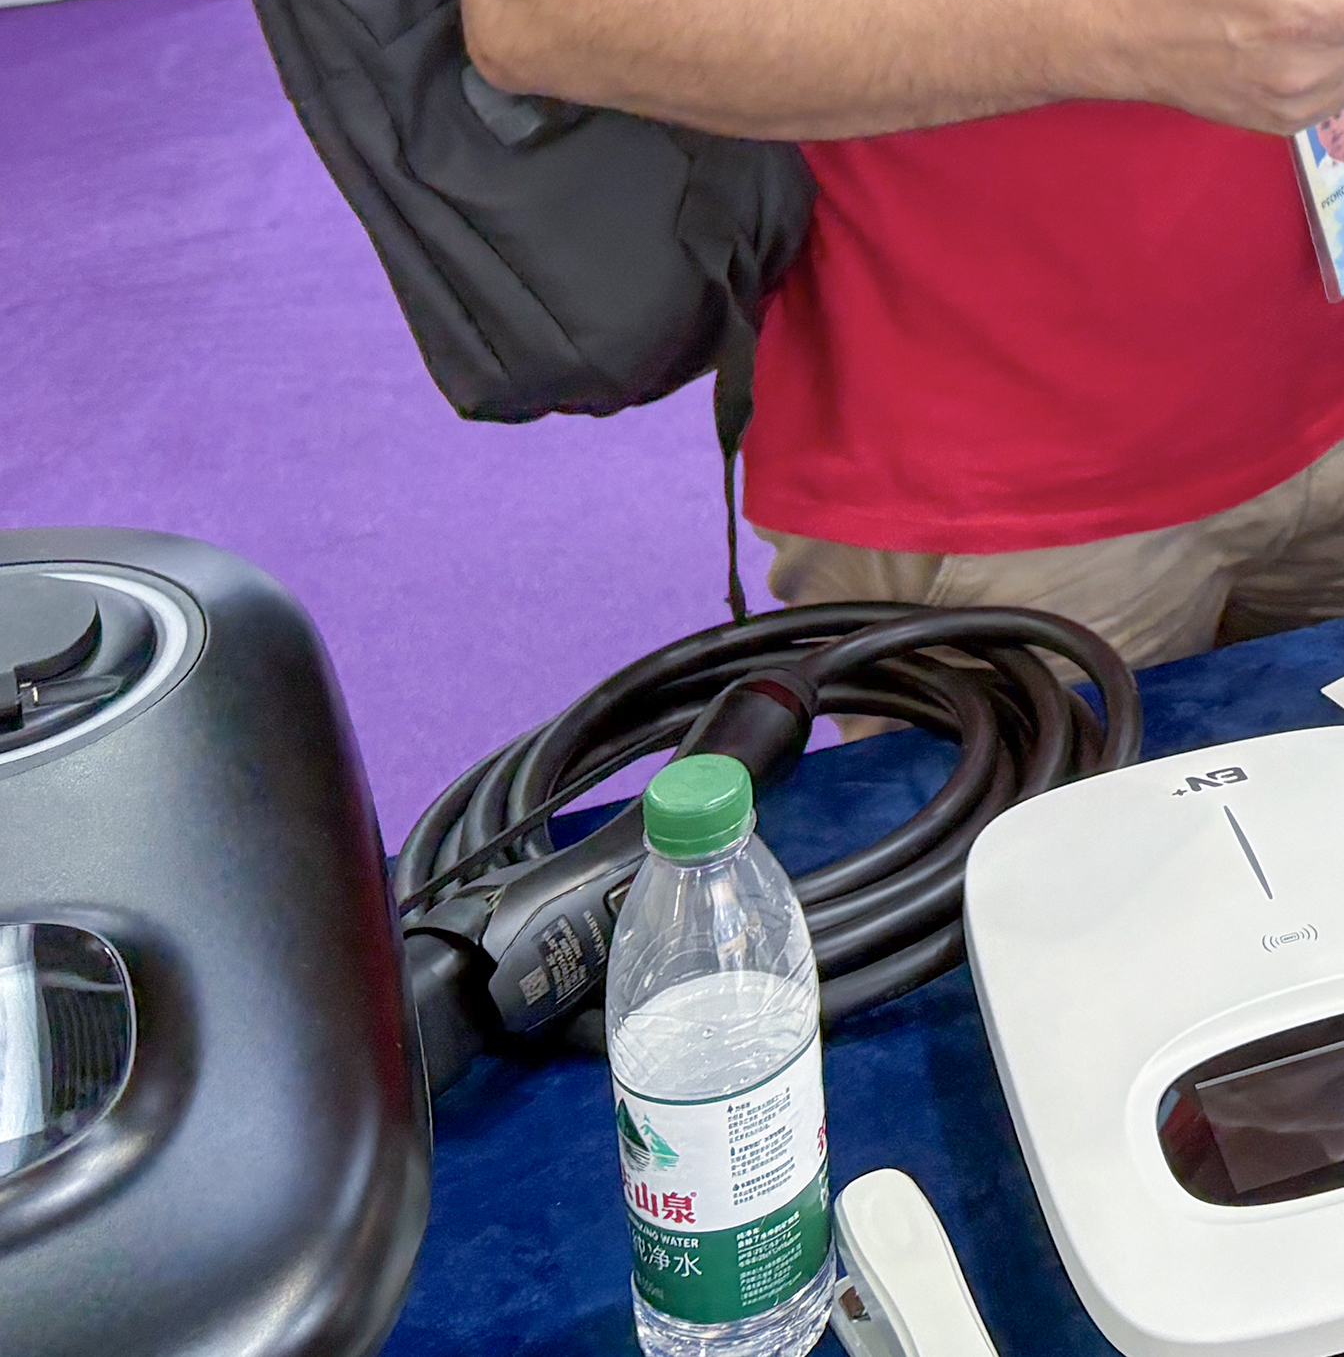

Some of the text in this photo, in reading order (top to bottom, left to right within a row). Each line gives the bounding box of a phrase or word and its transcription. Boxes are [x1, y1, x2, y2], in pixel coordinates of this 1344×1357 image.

[1172, 767, 1248, 796] EN+
[631, 1229, 703, 1278] 纯净水
[660, 1233, 700, 1249] WATER
